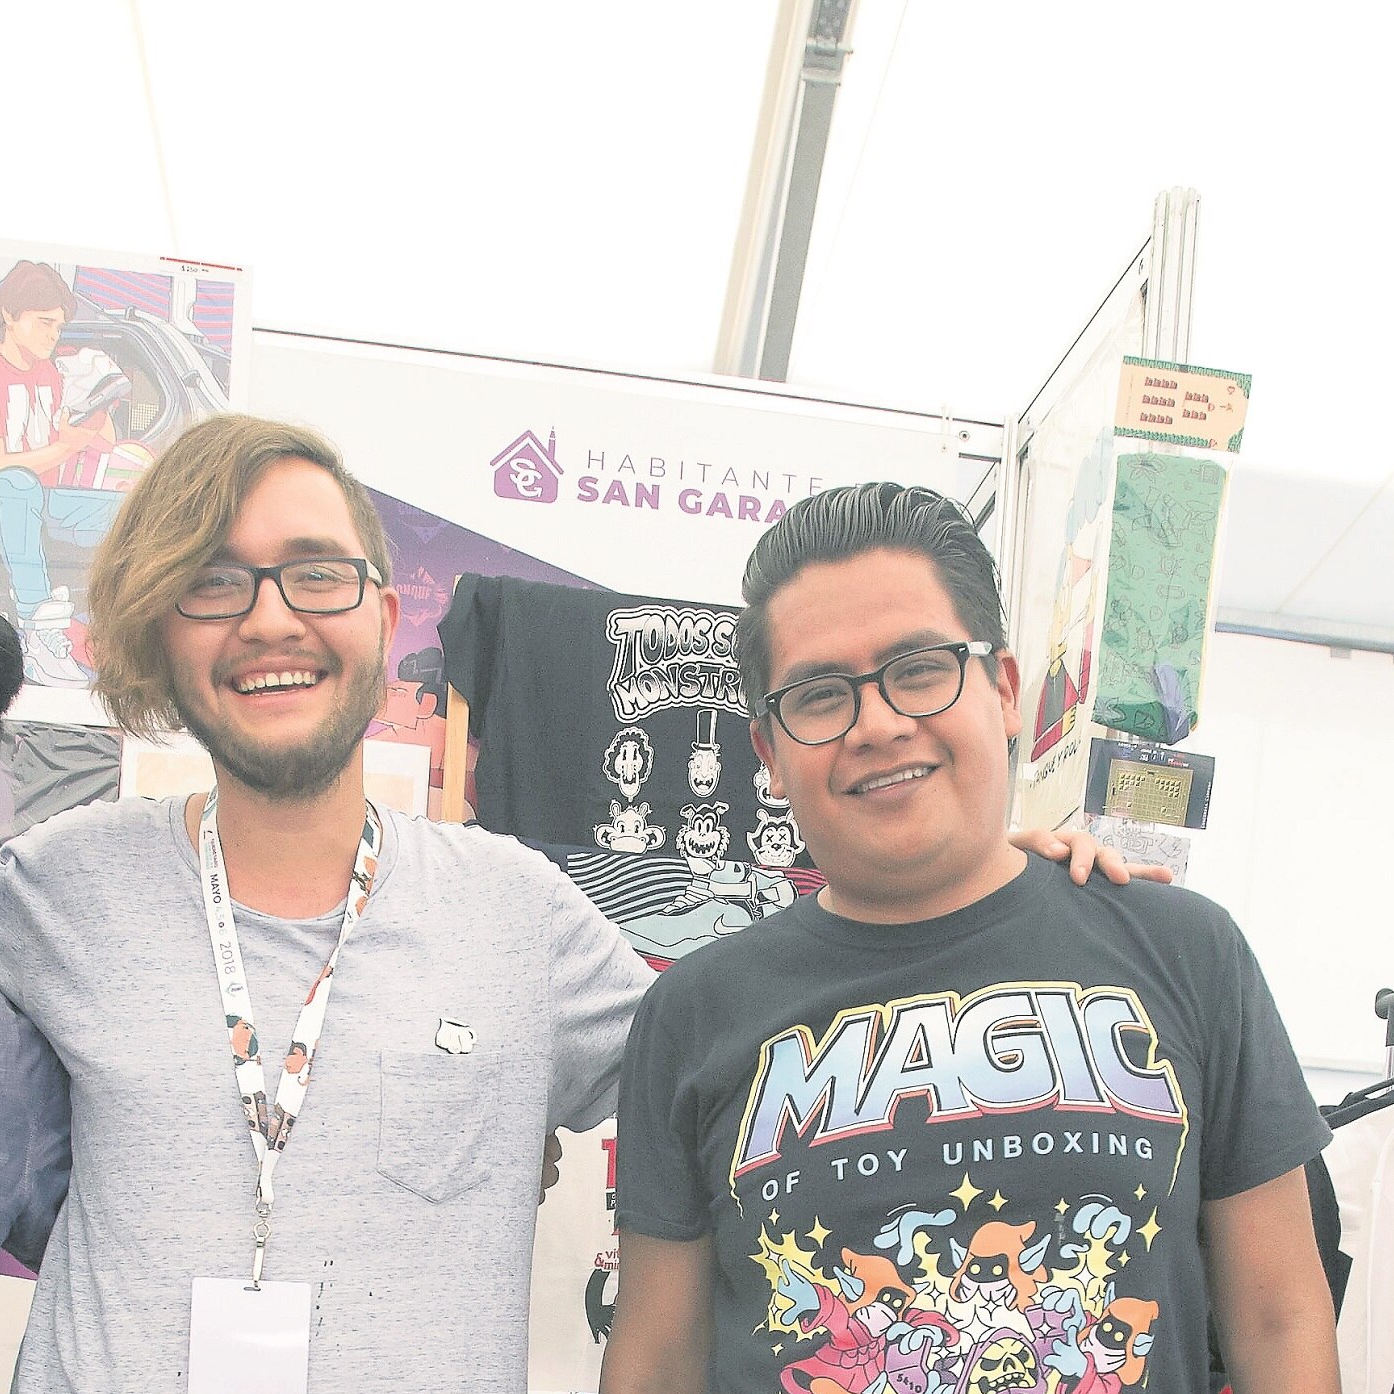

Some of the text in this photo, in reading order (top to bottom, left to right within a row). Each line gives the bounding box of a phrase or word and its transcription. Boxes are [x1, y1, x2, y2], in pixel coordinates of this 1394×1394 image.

[577, 475, 660, 510] SAN
[587, 449, 824, 497] HABITANTE
[614, 613, 714, 683] TODOS
[614, 661, 749, 716] MONSTR
[209, 873, 222, 904] MAYO
[218, 941, 236, 976] 2018
[738, 984, 1183, 1174] MAGIC
[762, 1132, 1154, 1200] OF TOY UNBOXING
